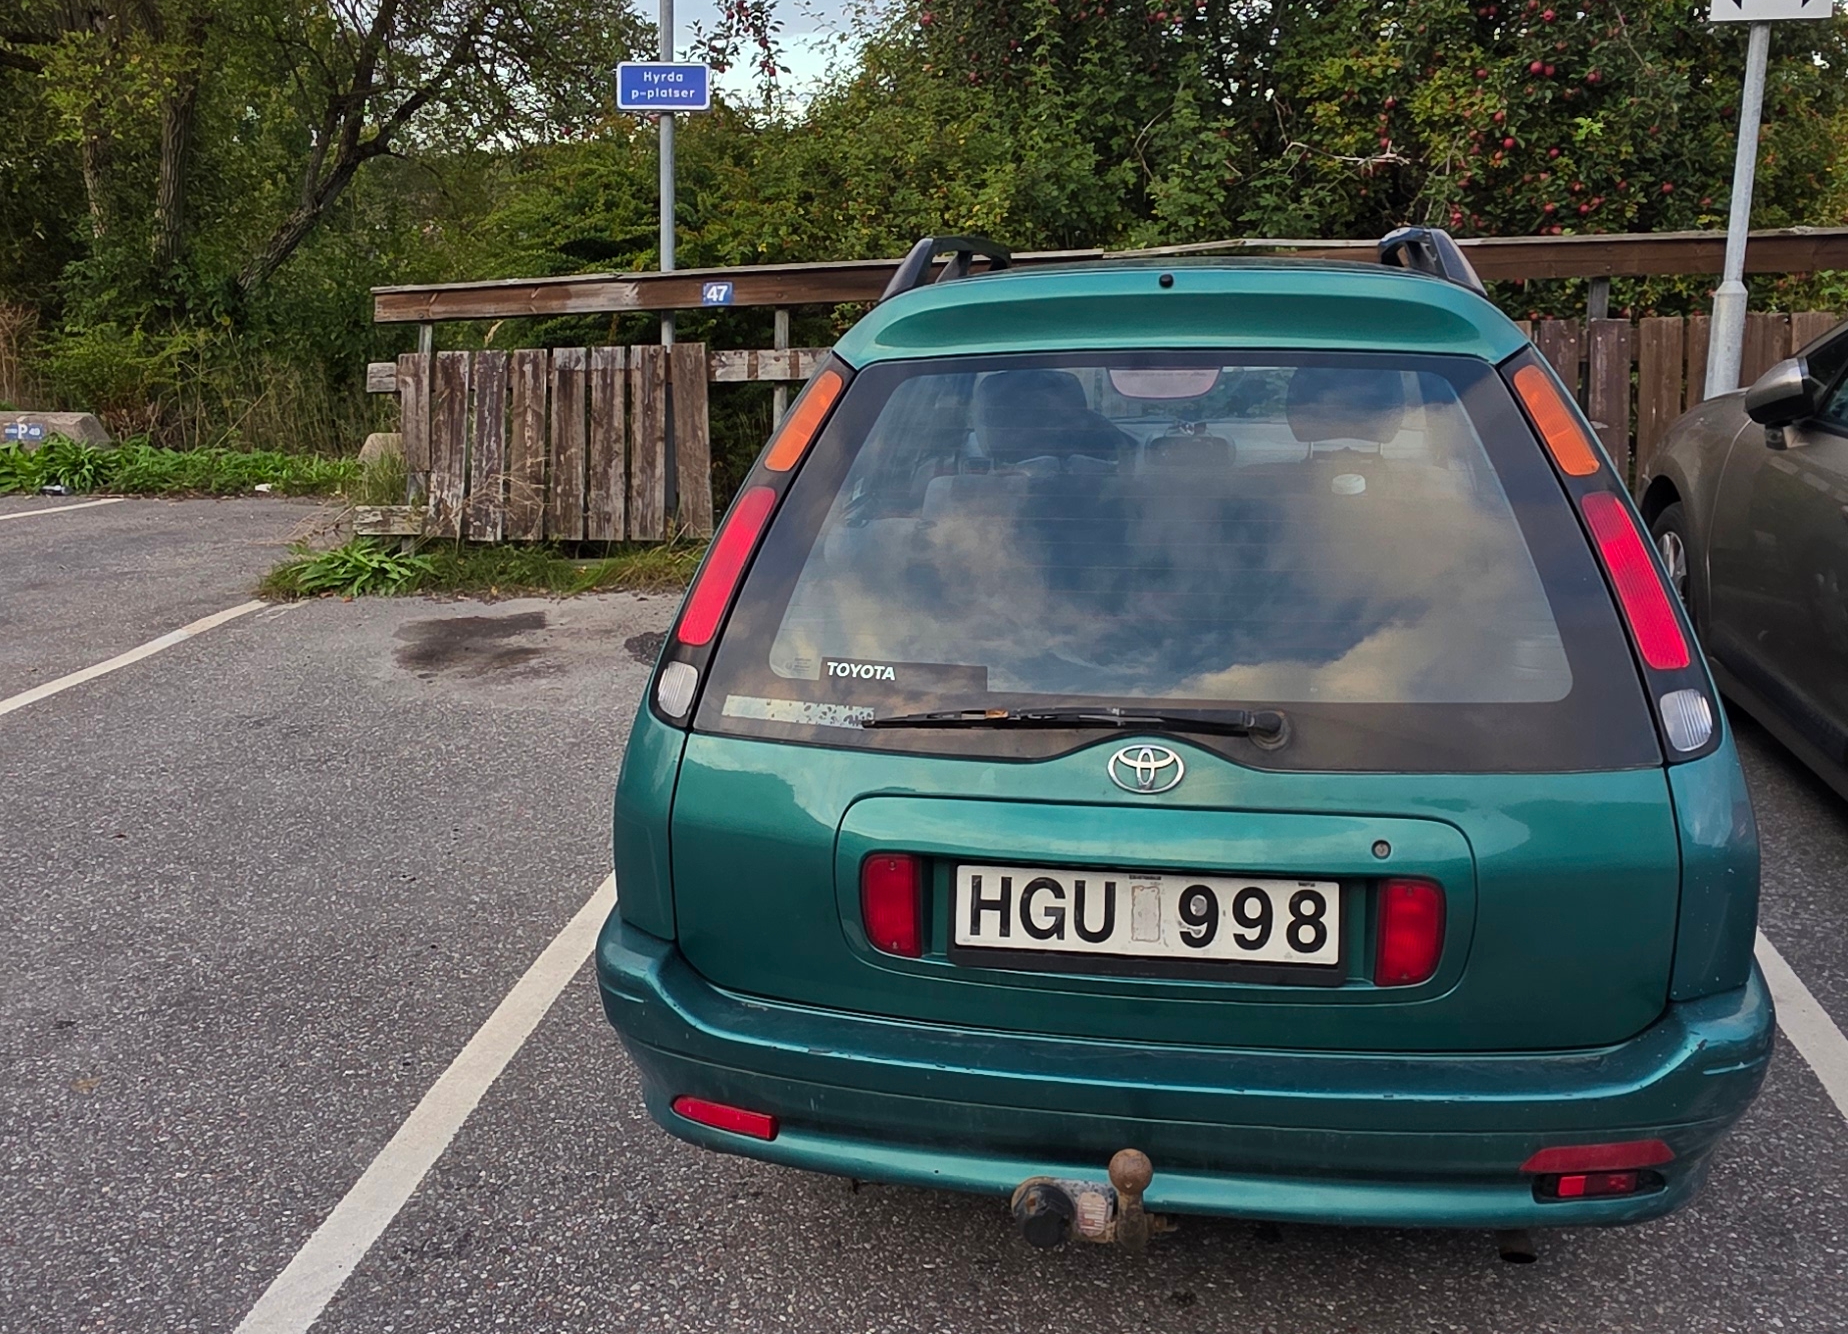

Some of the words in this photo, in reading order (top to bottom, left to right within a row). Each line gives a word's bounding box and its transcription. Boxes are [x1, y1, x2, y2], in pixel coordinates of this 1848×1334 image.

[643, 71, 684, 85] Hyrda
[631, 87, 696, 100] p-platser
[706, 285, 729, 302] 47
[18, 424, 28, 439] P
[826, 661, 896, 681] TOYOTA
[969, 874, 1117, 944] HGU
[1178, 884, 1328, 954] 998
